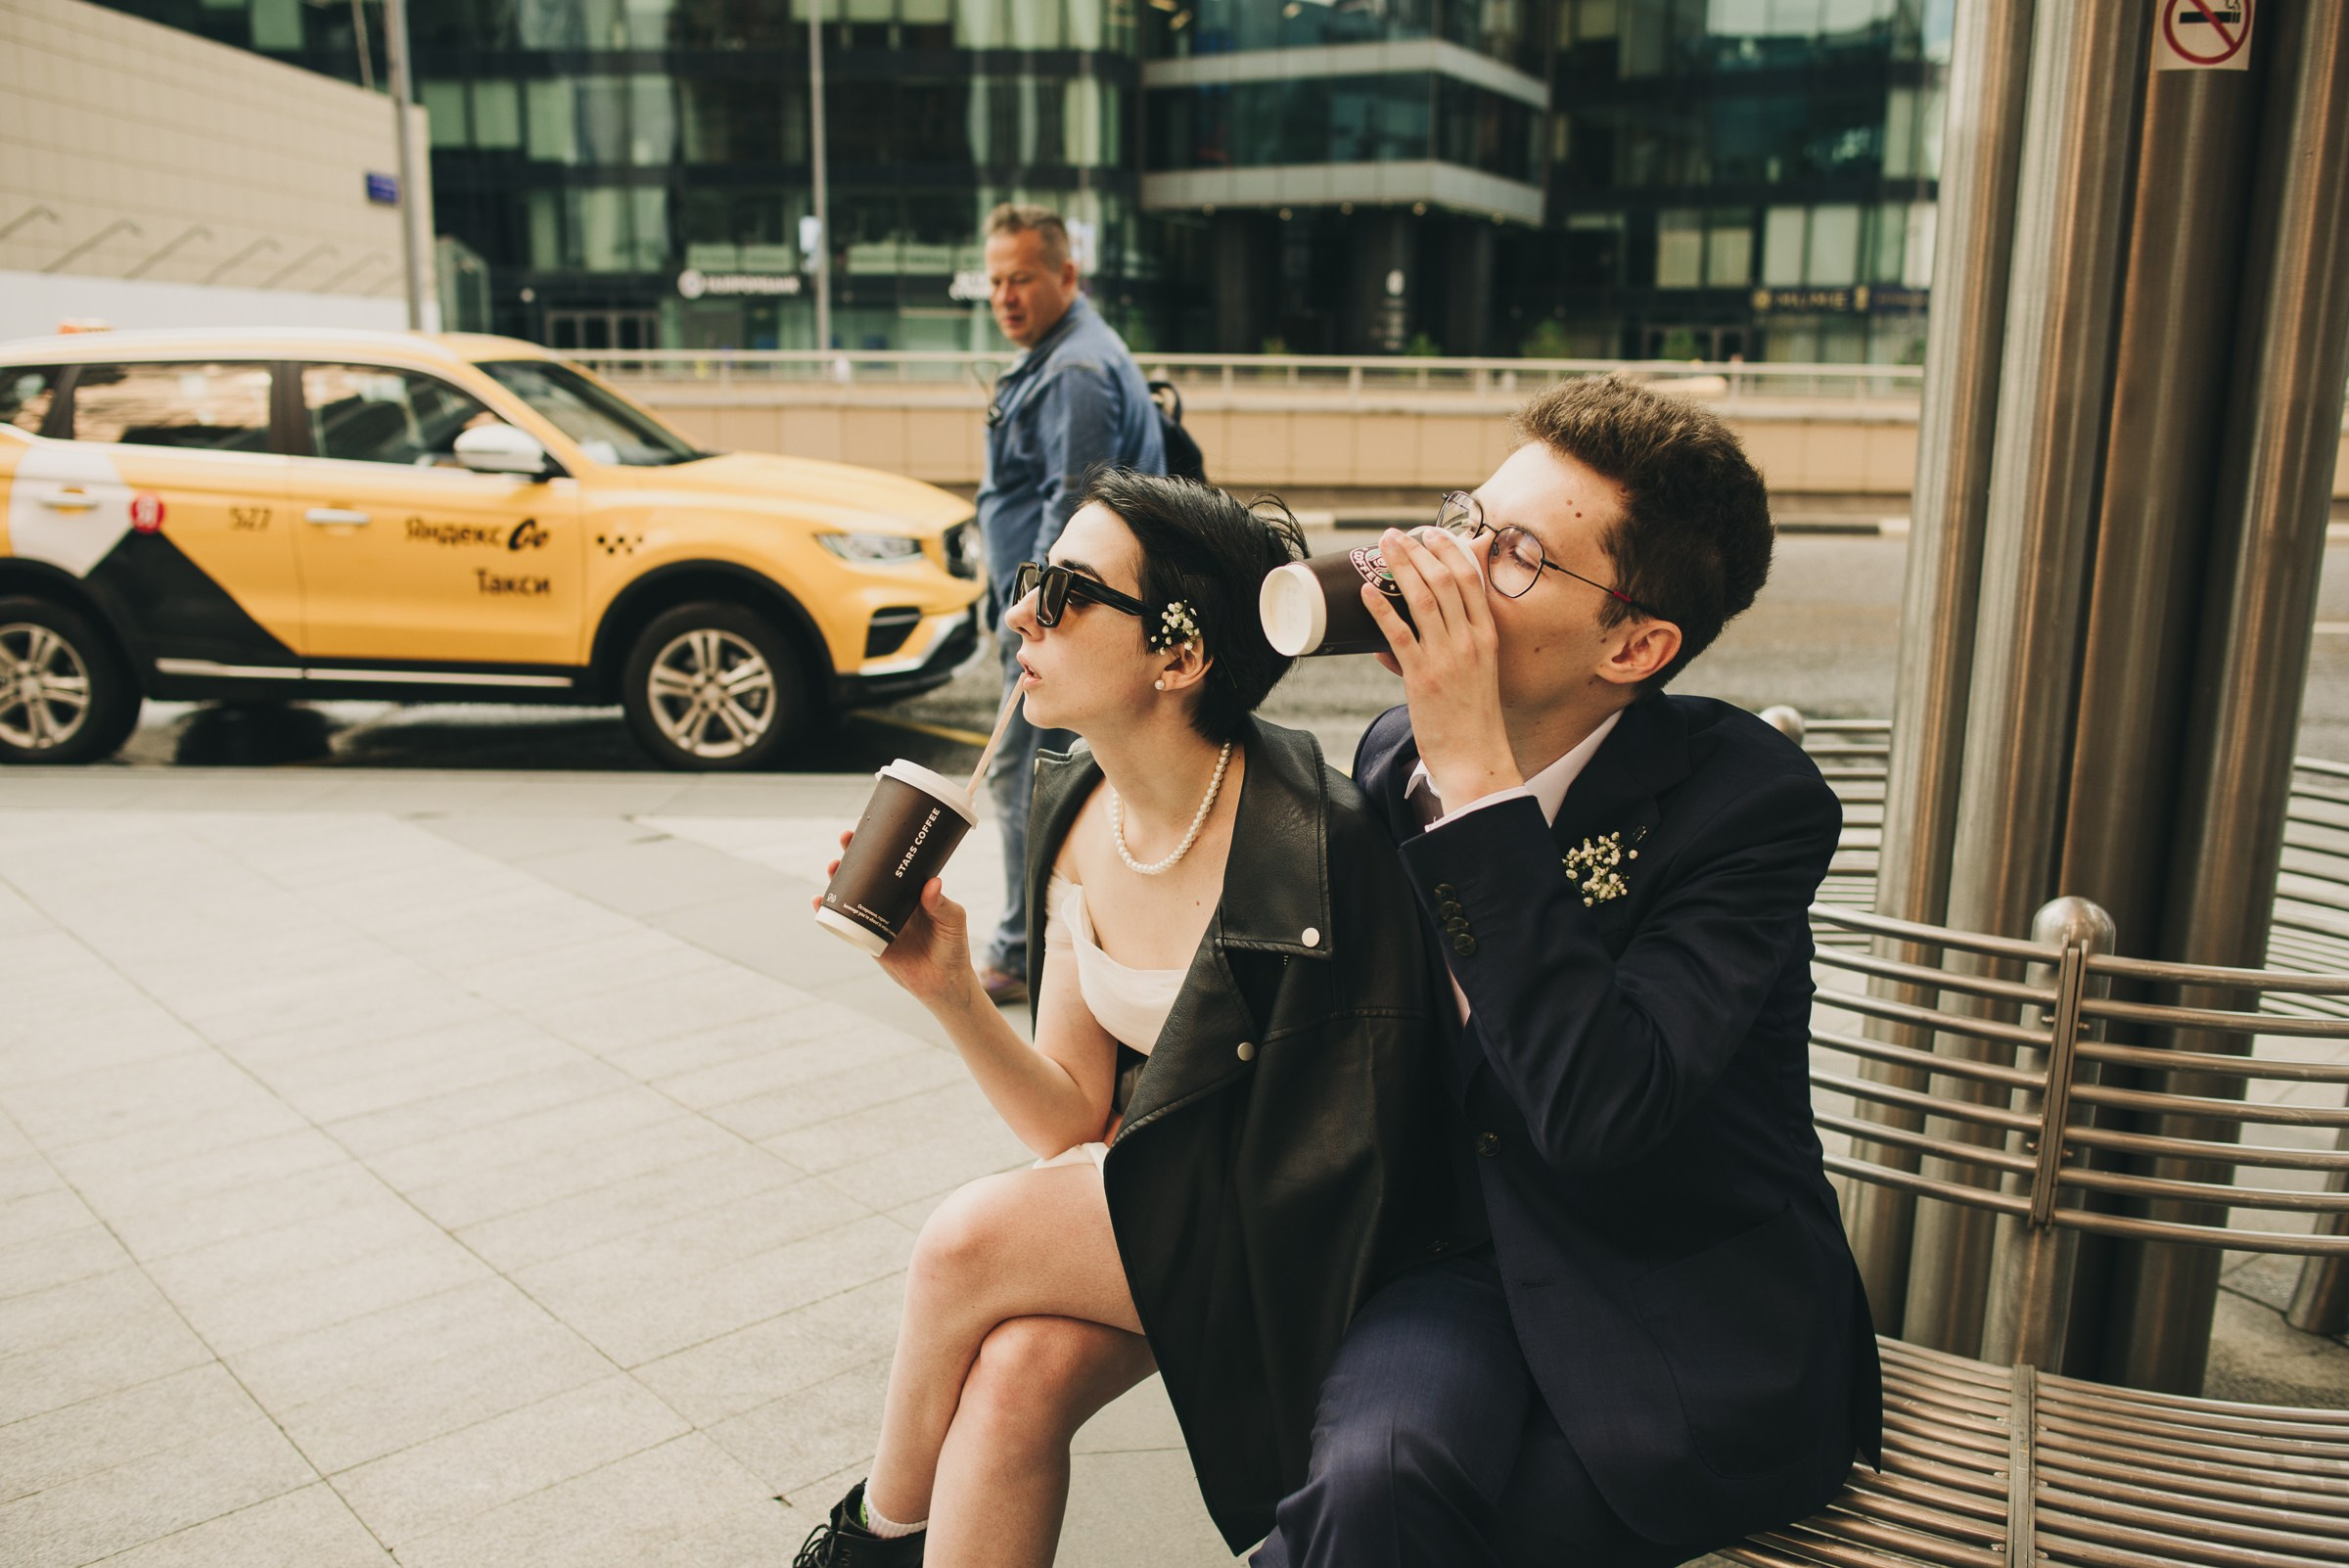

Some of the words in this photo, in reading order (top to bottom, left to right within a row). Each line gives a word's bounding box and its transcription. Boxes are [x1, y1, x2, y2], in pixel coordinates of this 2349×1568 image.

[404, 516, 502, 548] Яндекс
[507, 517, 550, 552] Go
[476, 567, 551, 596] Такси
[895, 846, 918, 878] STARS
[914, 807, 941, 846] COFFEE
